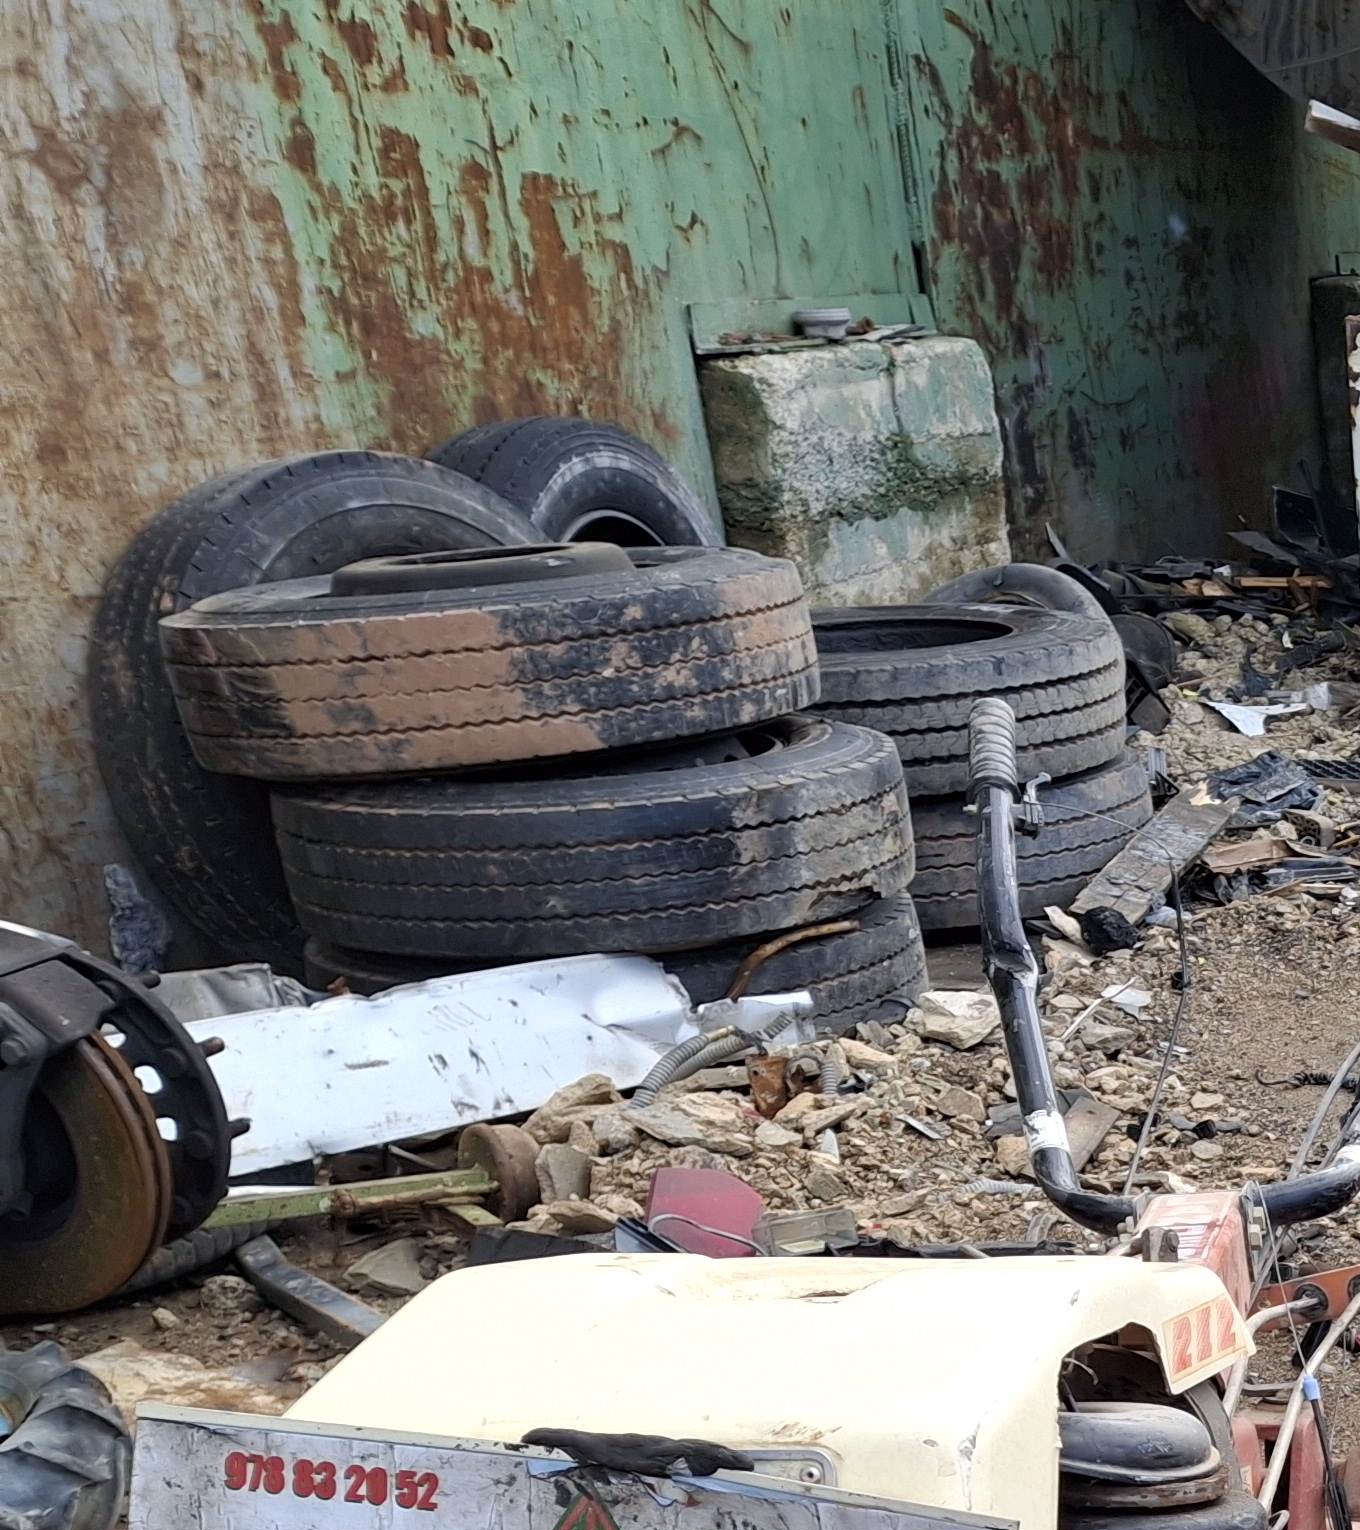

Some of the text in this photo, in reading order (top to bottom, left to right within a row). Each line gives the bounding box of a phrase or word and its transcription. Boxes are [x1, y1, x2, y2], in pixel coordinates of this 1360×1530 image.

[224, 1451, 439, 1512] 978 83 20 52
